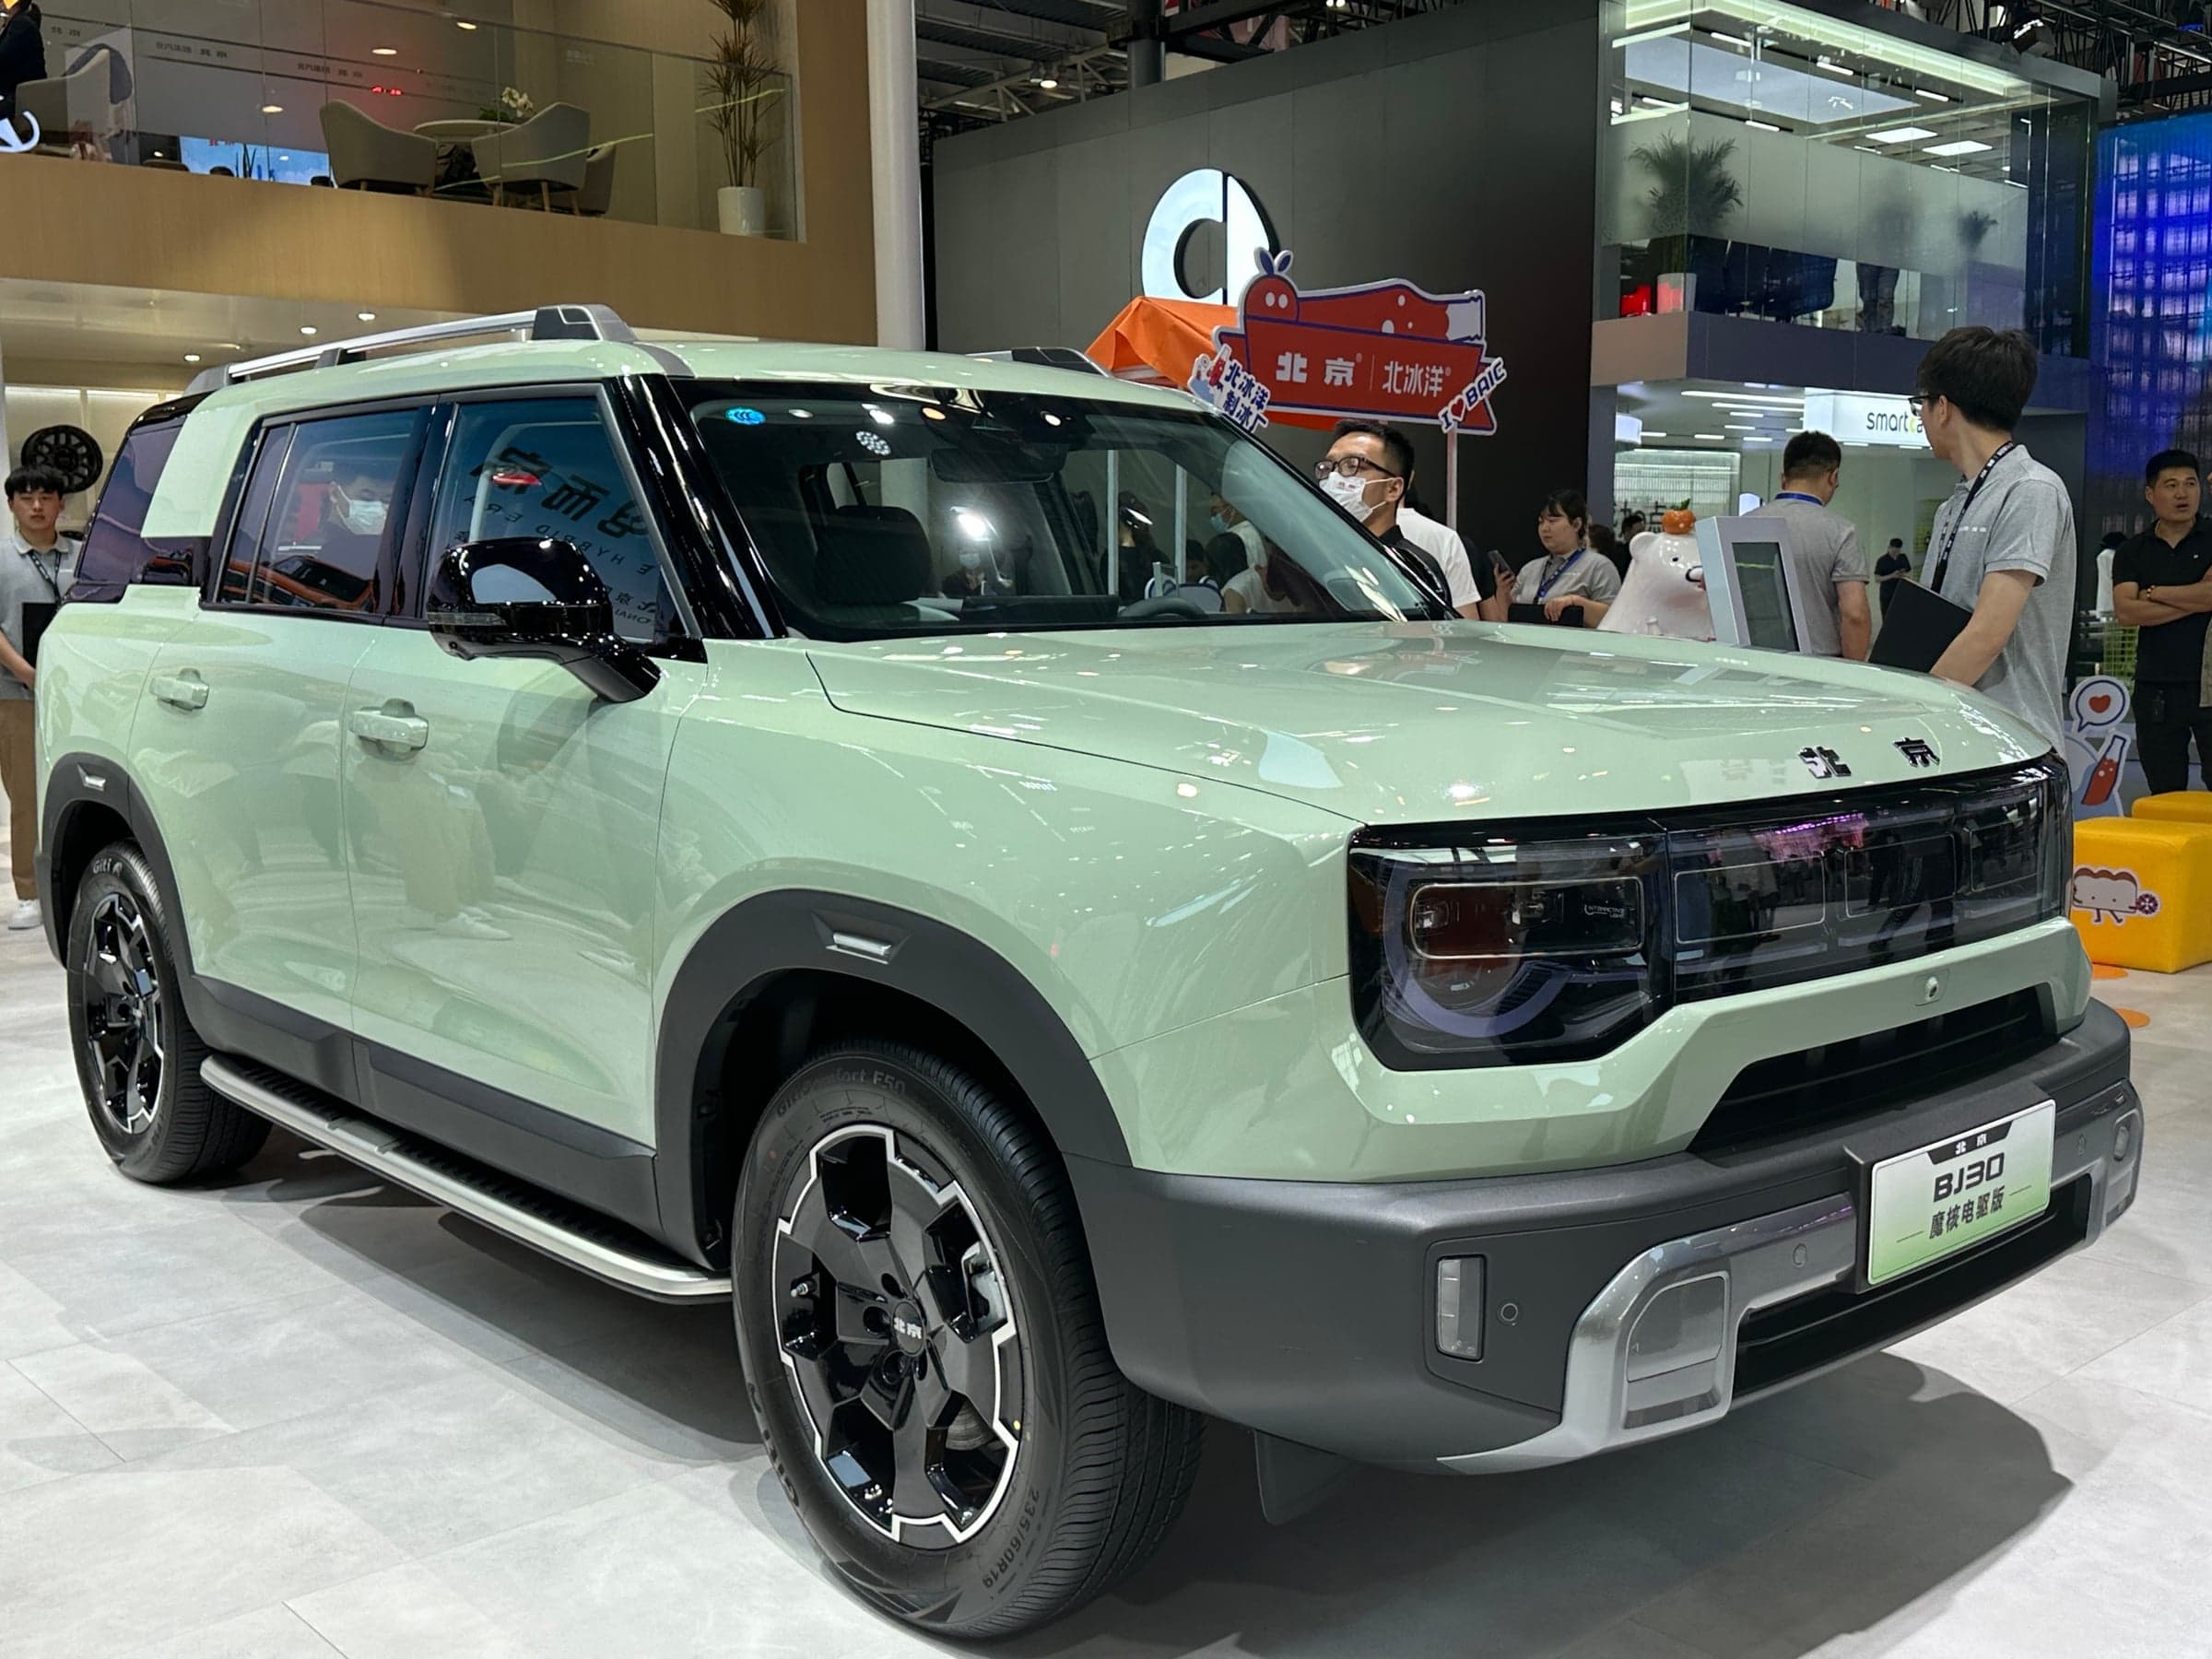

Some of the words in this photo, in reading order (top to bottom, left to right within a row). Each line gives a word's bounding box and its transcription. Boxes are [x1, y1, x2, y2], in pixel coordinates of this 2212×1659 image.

[1224, 362, 1269, 410] 北冰洋
[1276, 351, 1355, 387] 北京
[1382, 360, 1443, 397] 北冰洋
[1465, 360, 1506, 407] BAIC
[1797, 737, 1940, 779] 北京
[1955, 1134, 1987, 1155] 北京
[1934, 1152, 2006, 1203] BJ30
[1929, 1185, 2006, 1240] 魔核电驱版
[893, 1317, 923, 1340] 北京
